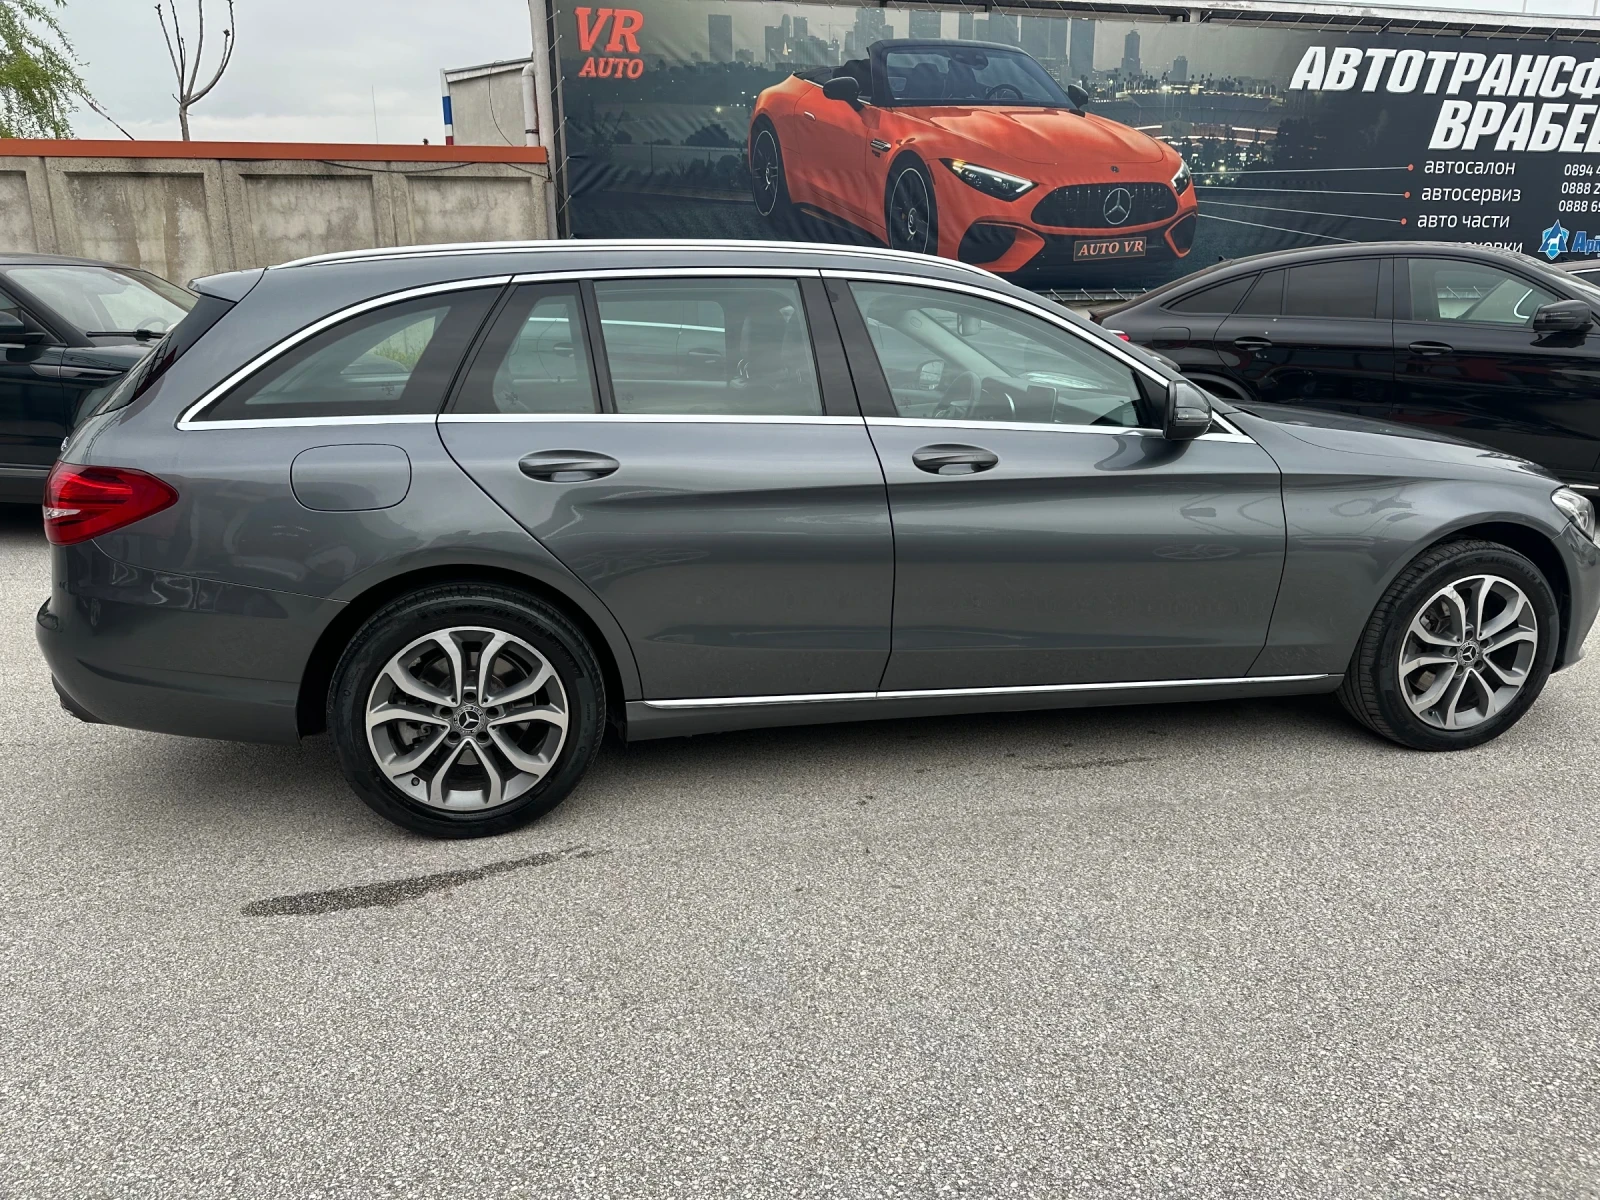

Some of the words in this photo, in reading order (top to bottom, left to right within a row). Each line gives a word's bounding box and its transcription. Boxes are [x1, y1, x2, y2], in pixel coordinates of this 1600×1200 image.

[574, 7, 644, 54] VR
[578, 57, 644, 79] AUTO
[1424, 160, 1516, 175] автосалон
[1564, 164, 1593, 176] 0894
[1421, 186, 1521, 205] автосервиз
[1561, 182, 1591, 194] 0888
[1558, 200, 1588, 212] 0888
[1417, 213, 1457, 228] авто
[1462, 213, 1510, 228] части
[1077, 241, 1120, 256] AUTO
[1124, 240, 1144, 253] VR
